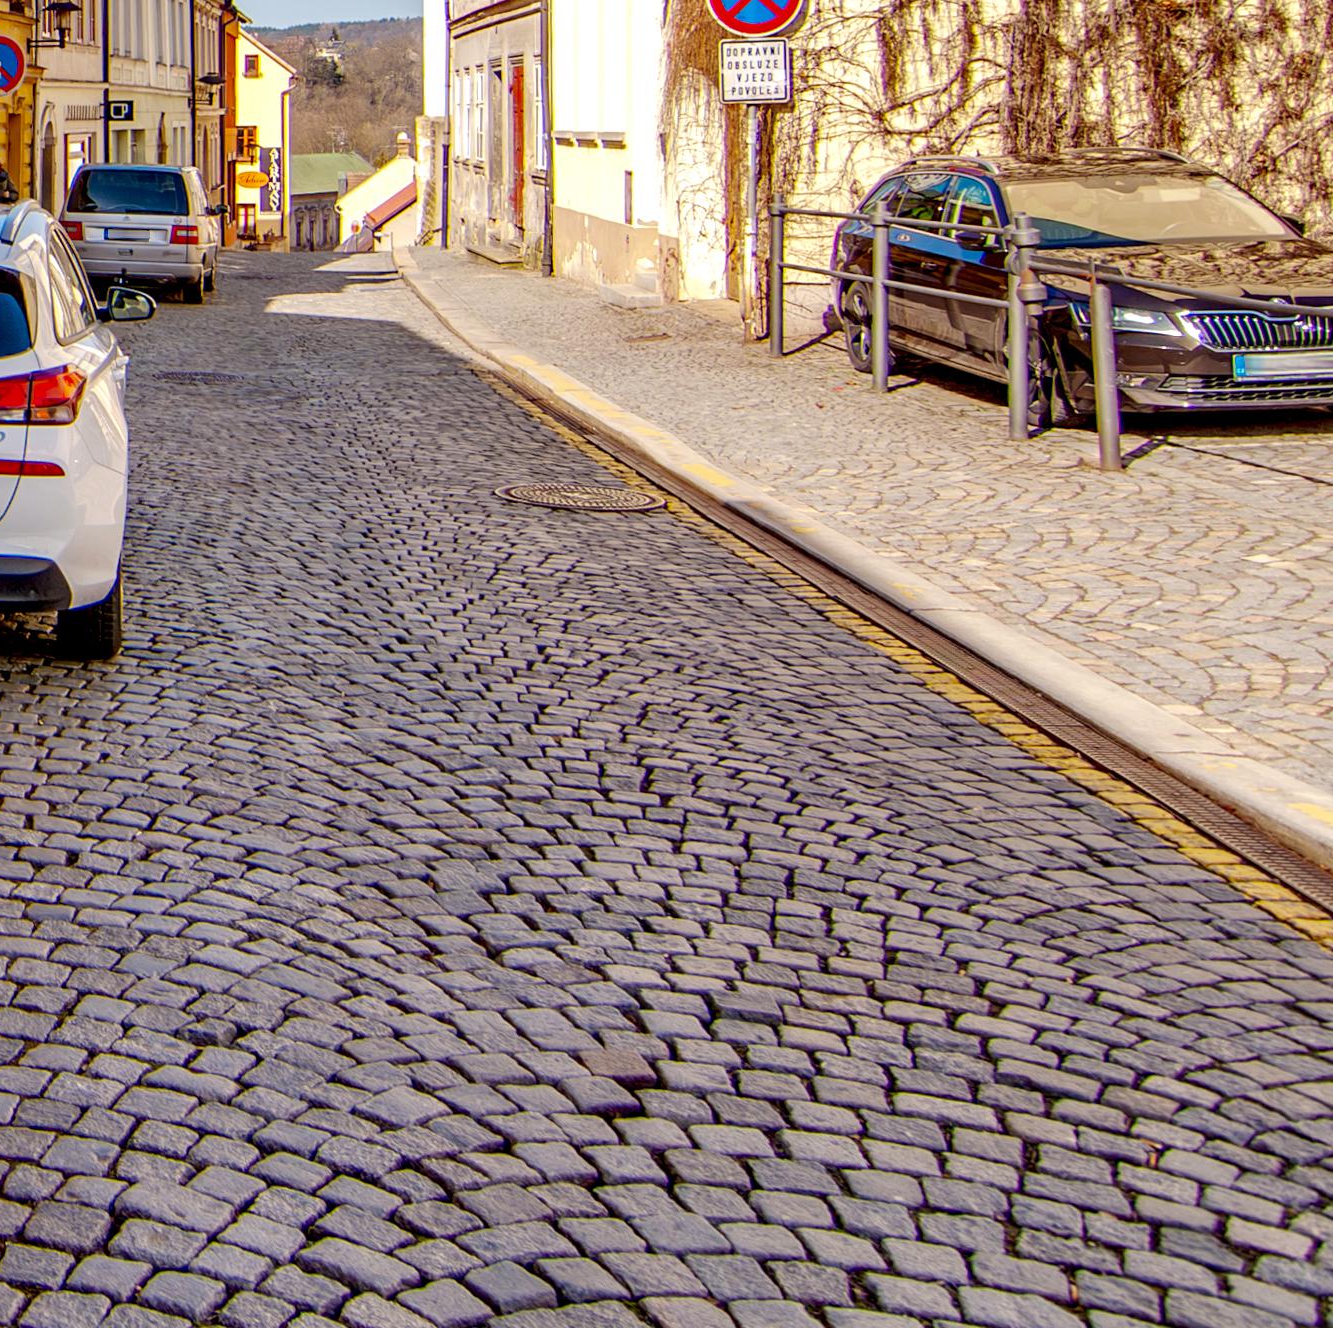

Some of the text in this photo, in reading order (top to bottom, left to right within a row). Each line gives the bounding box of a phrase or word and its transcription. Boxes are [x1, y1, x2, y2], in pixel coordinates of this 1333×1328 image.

[726, 44, 781, 57] DOPRAVNÍ
[727, 59, 779, 70] OBSLUZE
[736, 72, 773, 83] VJEZD
